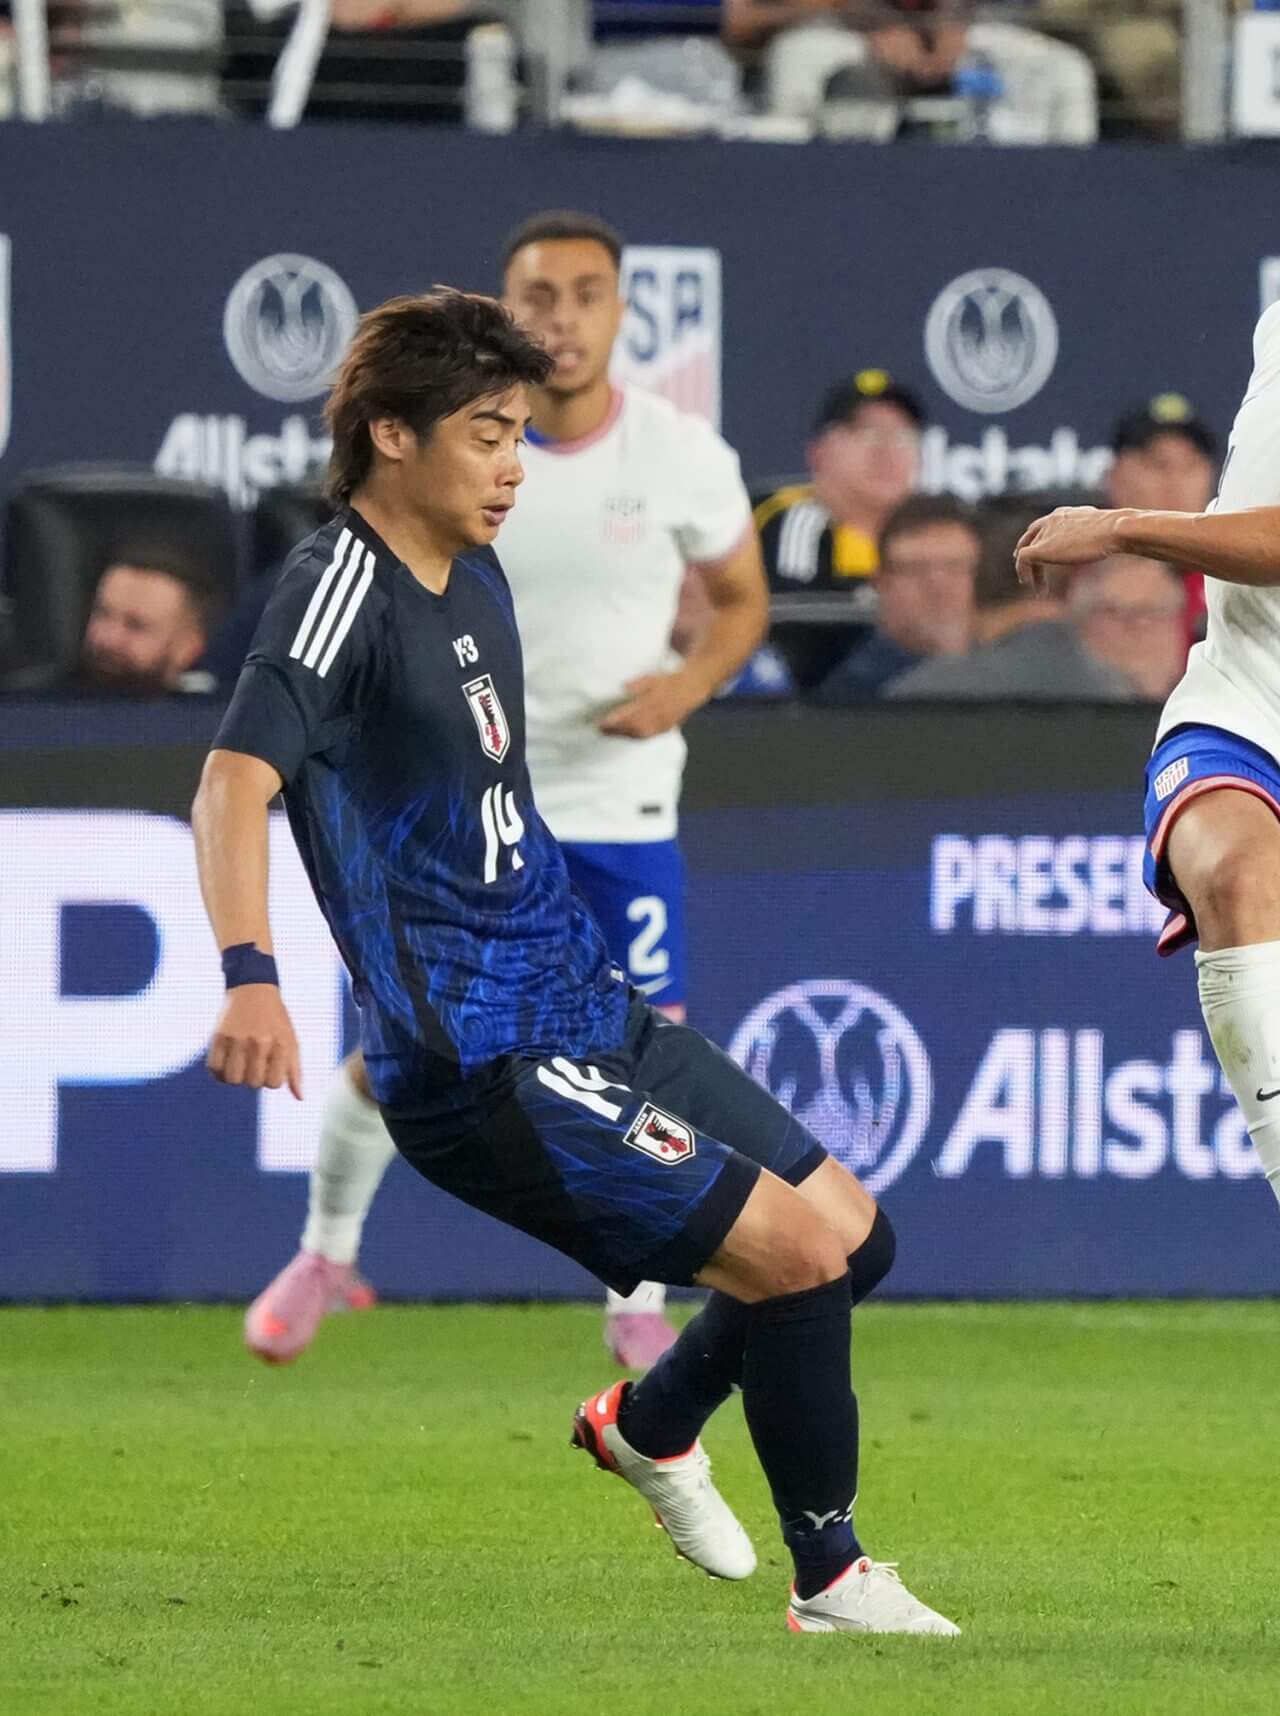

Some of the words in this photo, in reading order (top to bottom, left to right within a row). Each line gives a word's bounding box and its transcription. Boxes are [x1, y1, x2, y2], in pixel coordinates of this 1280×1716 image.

[452, 634, 480, 668] Y-3
[481, 782, 525, 884] 14
[626, 896, 669, 975] 2
[537, 1056, 632, 1121] 14
